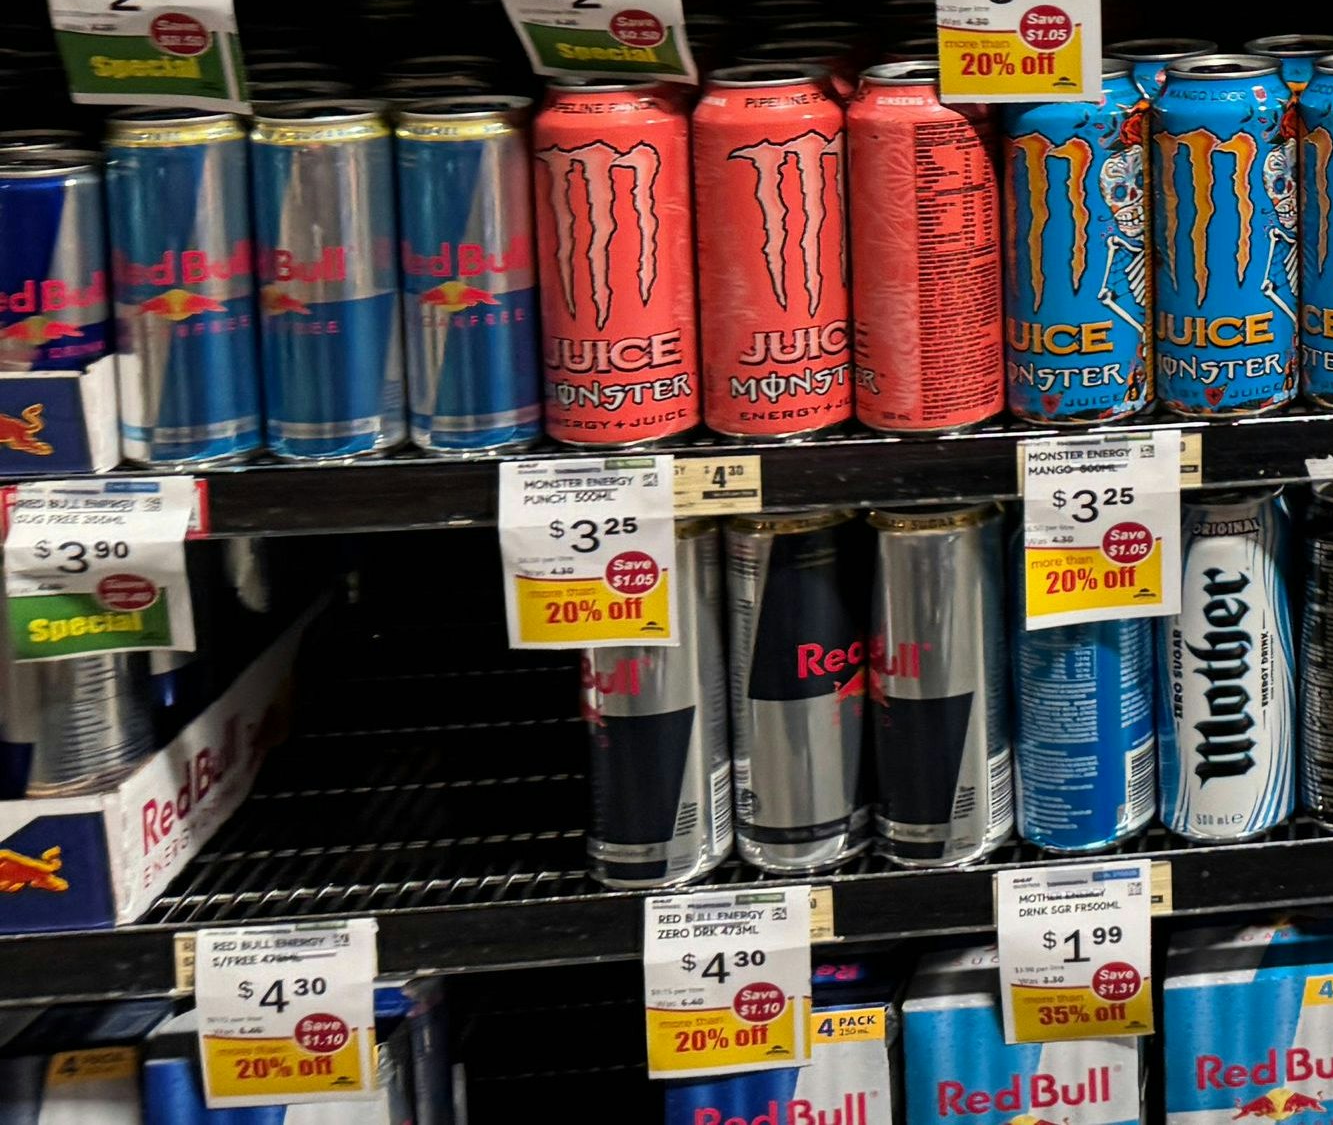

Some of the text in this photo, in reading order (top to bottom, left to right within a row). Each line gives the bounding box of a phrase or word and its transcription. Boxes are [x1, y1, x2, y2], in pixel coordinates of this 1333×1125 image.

[1027, 13, 1066, 25] Save
[1026, 29, 1068, 42] $1.05
[961, 52, 1055, 76] 20% off
[1157, 311, 1274, 348] JUICE
[547, 329, 682, 372] JUICE
[1028, 449, 1132, 461] MONSTER ENERGY
[524, 476, 632, 491] MONSTER ENERGY
[1110, 530, 1146, 540] Save
[1192, 518, 1260, 537] ORIGINAL
[1109, 544, 1148, 557] $1.05
[613, 560, 651, 571] Save
[613, 575, 655, 587] $1.05
[1046, 566, 1136, 595] 20% off
[544, 598, 643, 624] 20% off
[1100, 969, 1134, 981] Save
[740, 990, 778, 1001] Save
[1099, 983, 1136, 996] $1.31
[1038, 1002, 1126, 1026] 35% off
[675, 1025, 769, 1053] 20% off
[235, 1055, 334, 1080] 20% off
[1195, 1048, 1276, 1091] Red
[937, 1066, 1110, 1117] Red Bull
